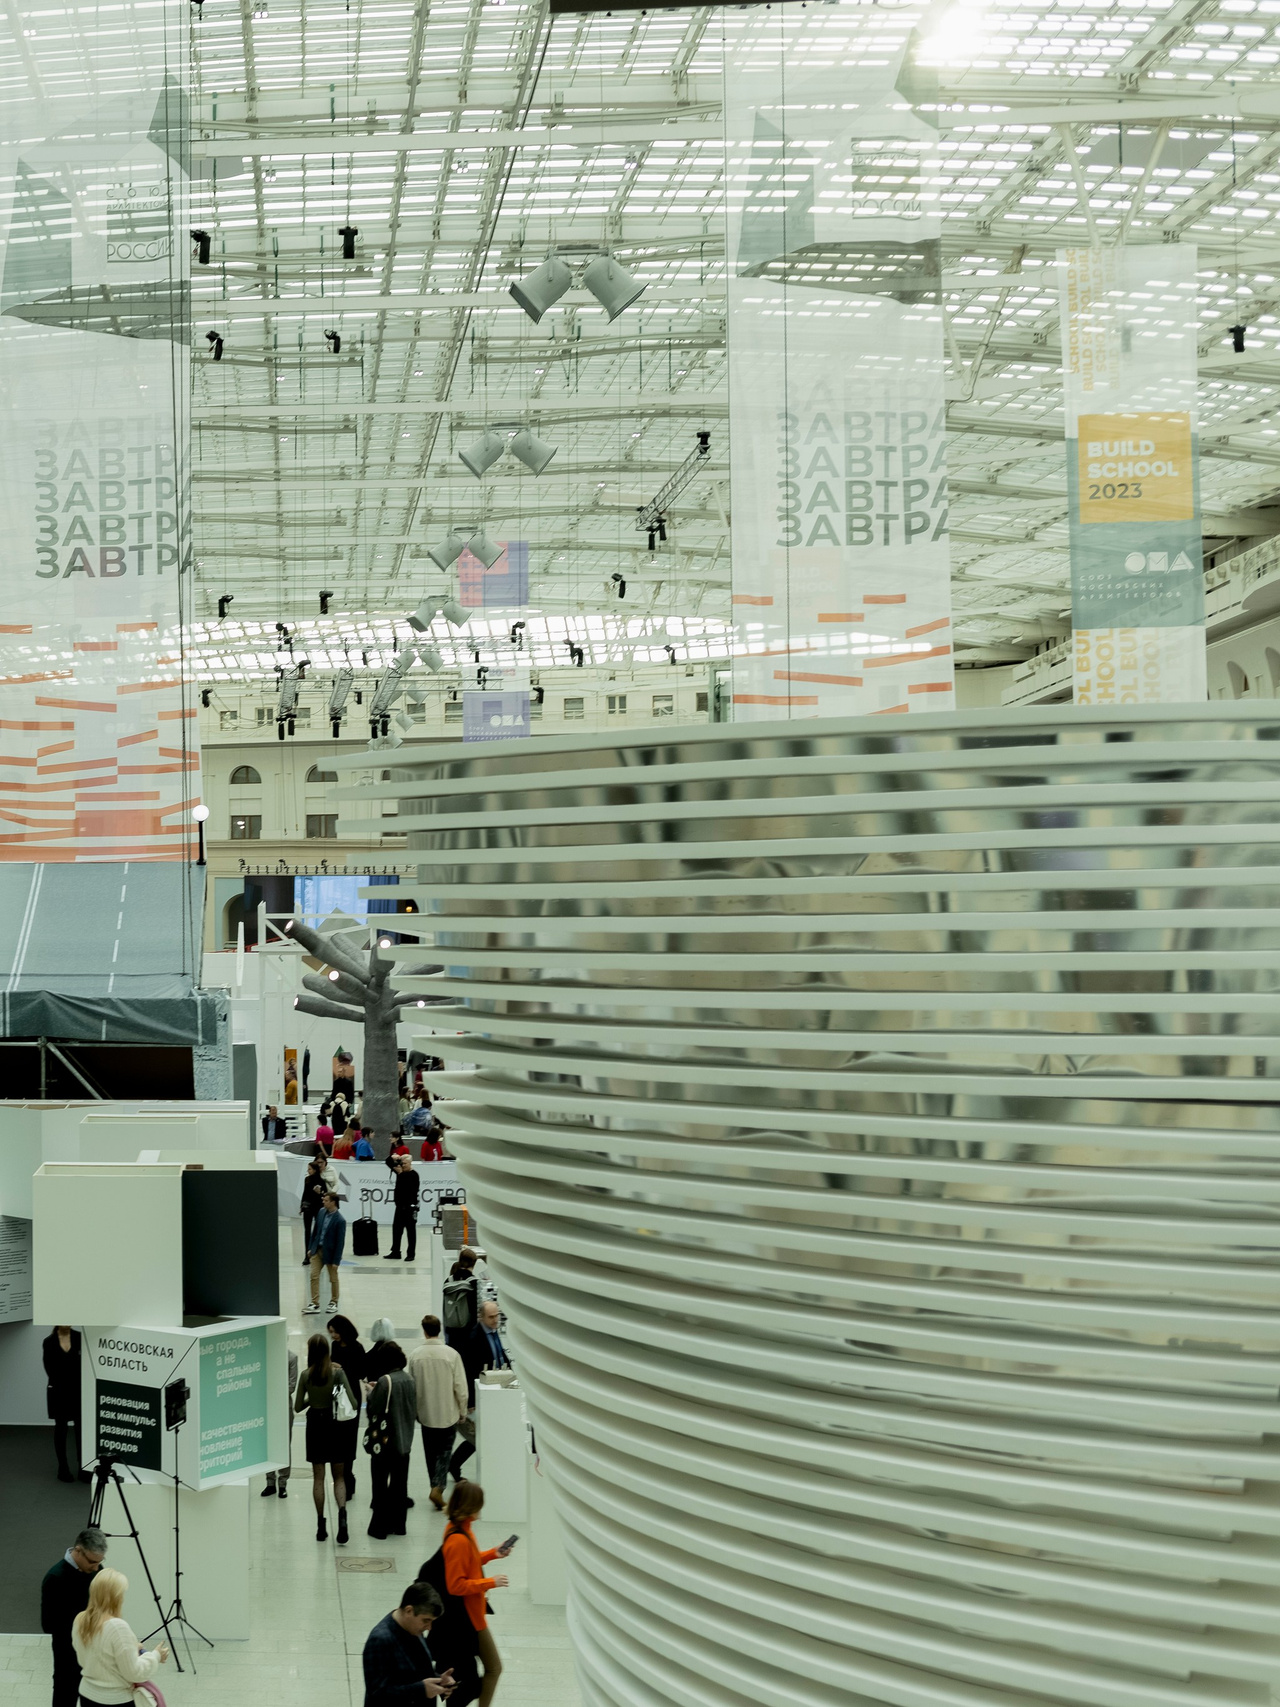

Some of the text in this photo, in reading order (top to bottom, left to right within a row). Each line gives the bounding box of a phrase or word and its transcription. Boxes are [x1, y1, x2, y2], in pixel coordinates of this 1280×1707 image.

[1079, 248, 1090, 282] BUIL
[1087, 440, 1155, 458] BUILD
[1087, 461, 1179, 478] SCHOOL
[1088, 483, 1143, 500] 2023
[359, 1187, 466, 1204] ЗОДСТВО
[98, 1338, 174, 1359] МОСКОВСКАЯ
[216, 1336, 251, 1353] города,
[98, 1355, 148, 1372] ОБЛАСТЬ
[216, 1353, 236, 1366] а не
[216, 1361, 261, 1381] спальные
[216, 1378, 252, 1397] районы
[100, 1395, 150, 1410] реновация
[100, 1409, 156, 1427] как импульс
[100, 1424, 142, 1439] развития
[201, 1416, 265, 1441] качественное
[100, 1439, 138, 1453] городов
[199, 1436, 243, 1456] новление
[199, 1448, 243, 1472] рриторий
